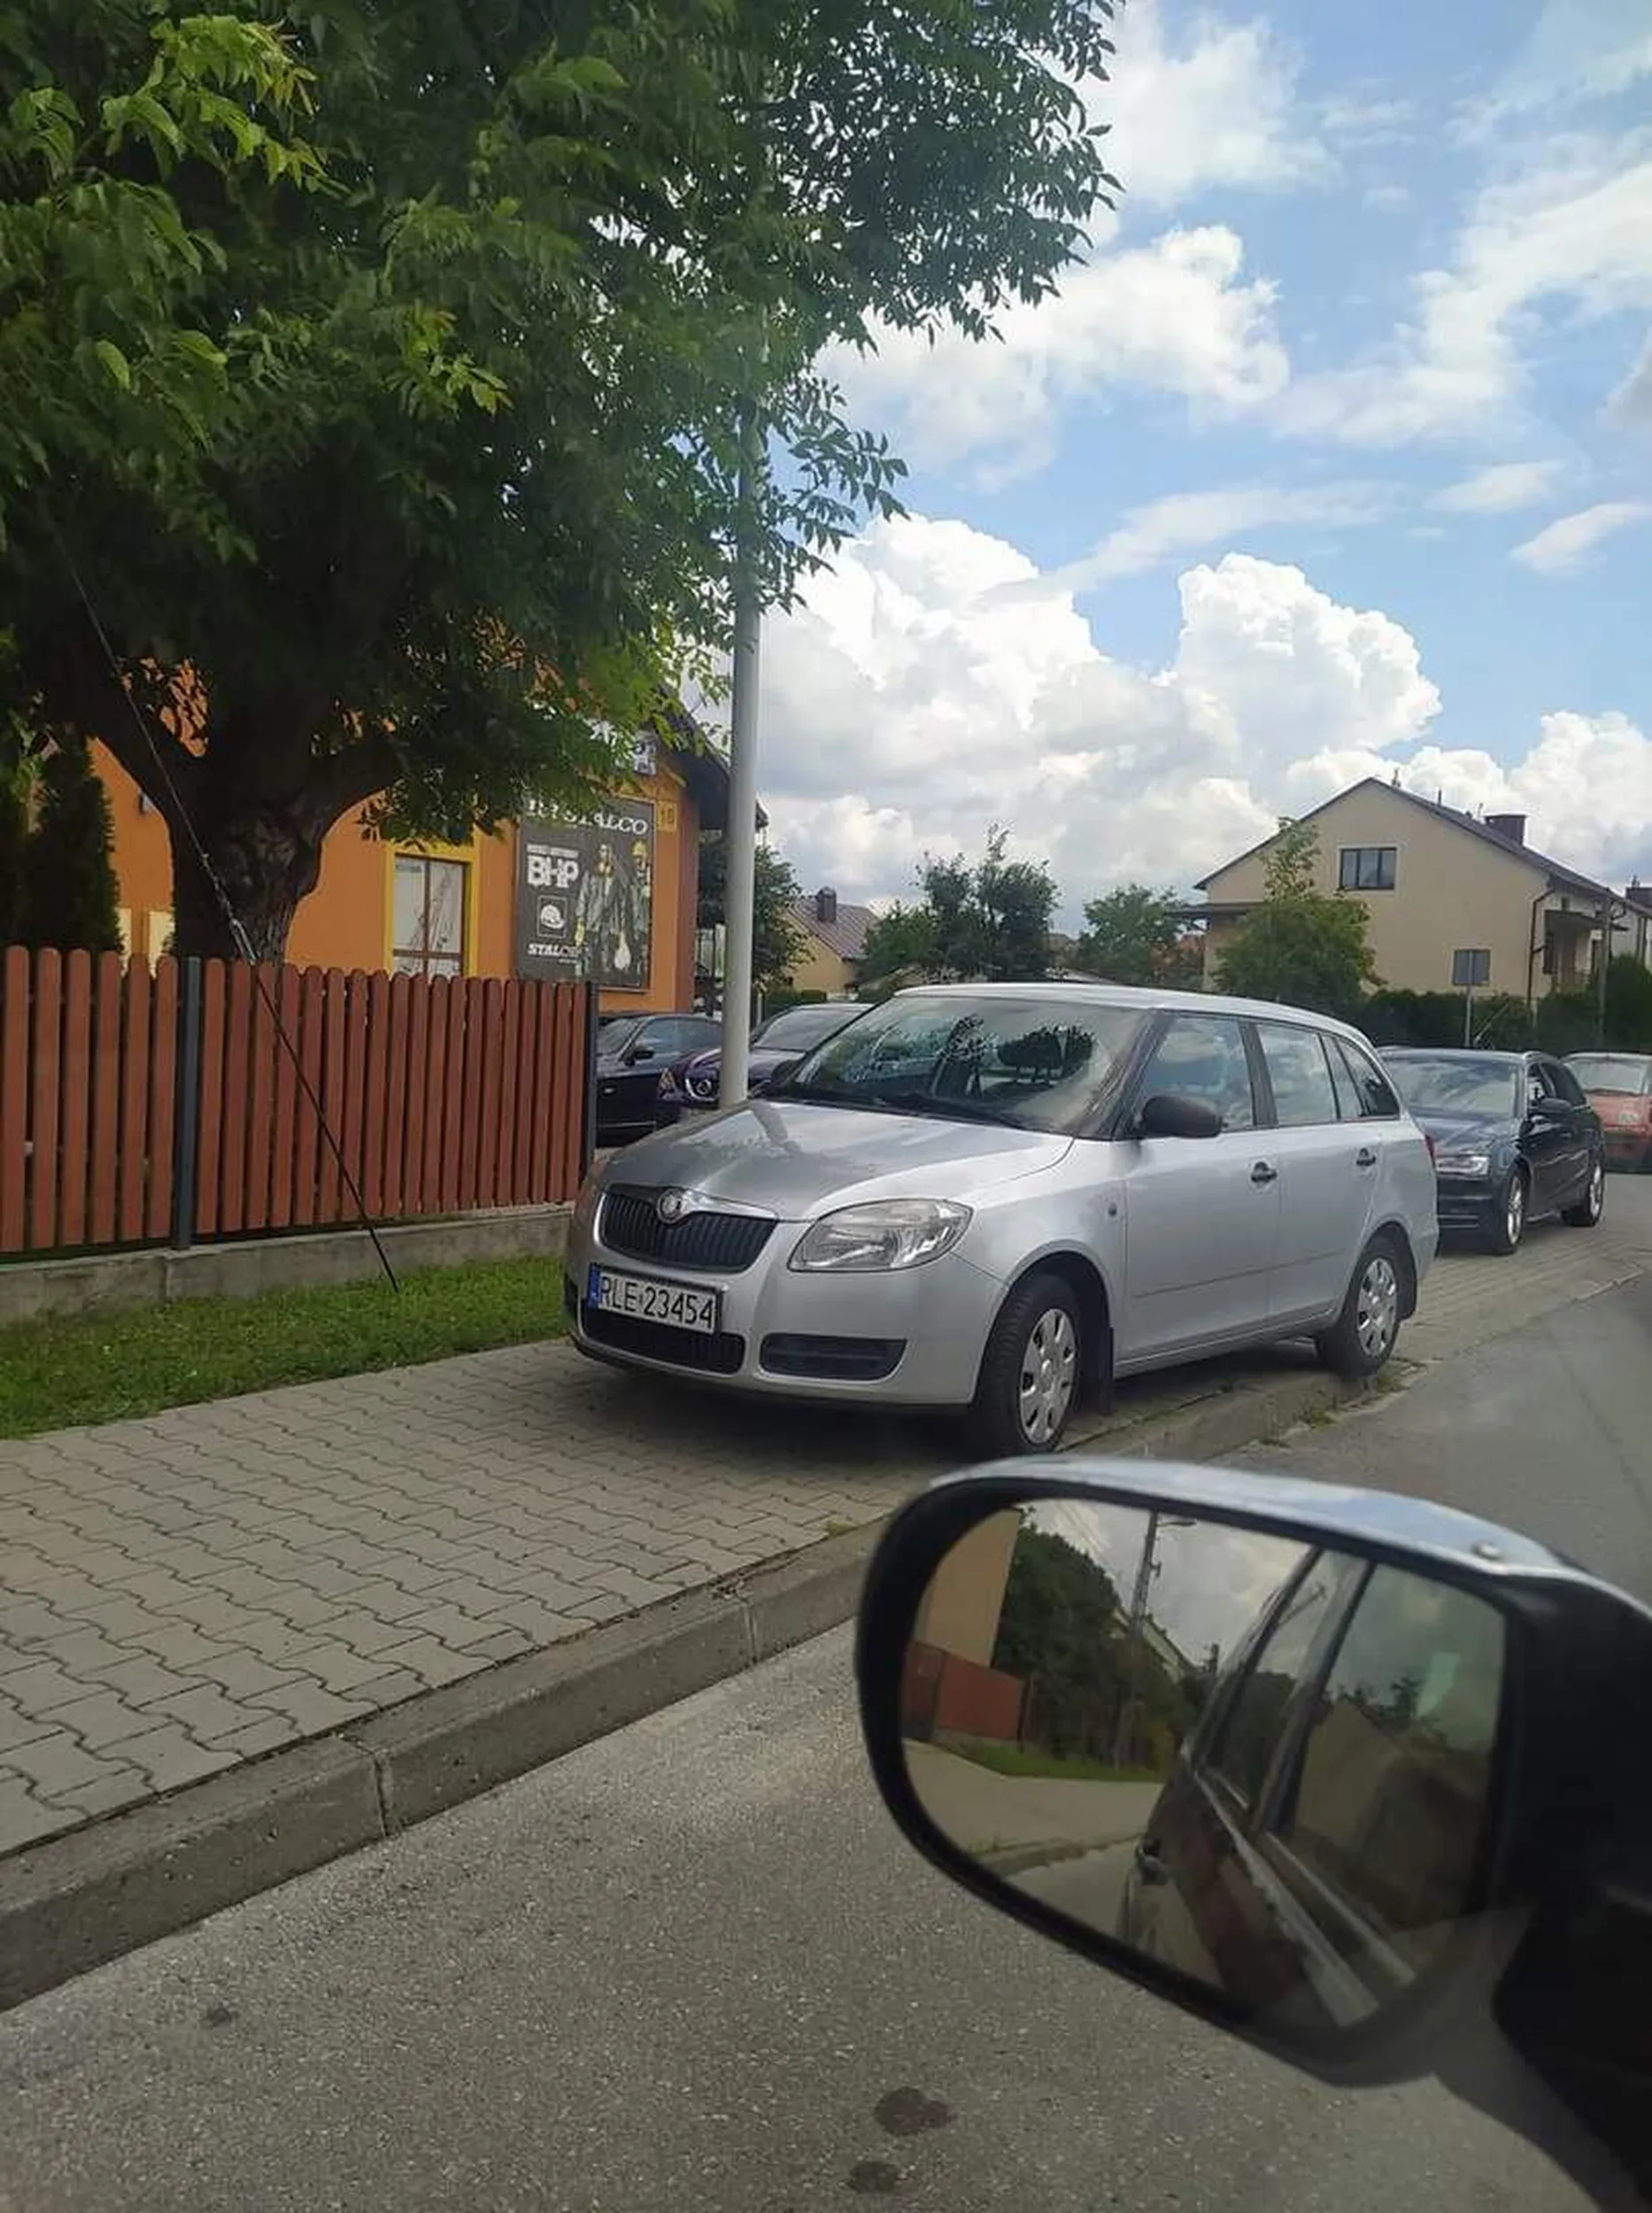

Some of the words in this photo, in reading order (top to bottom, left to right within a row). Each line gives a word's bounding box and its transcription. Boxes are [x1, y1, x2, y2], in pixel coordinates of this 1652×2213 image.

[528, 855, 579, 889] BHP
[600, 1276, 637, 1312] RLE
[644, 1286, 714, 1329] 23454
